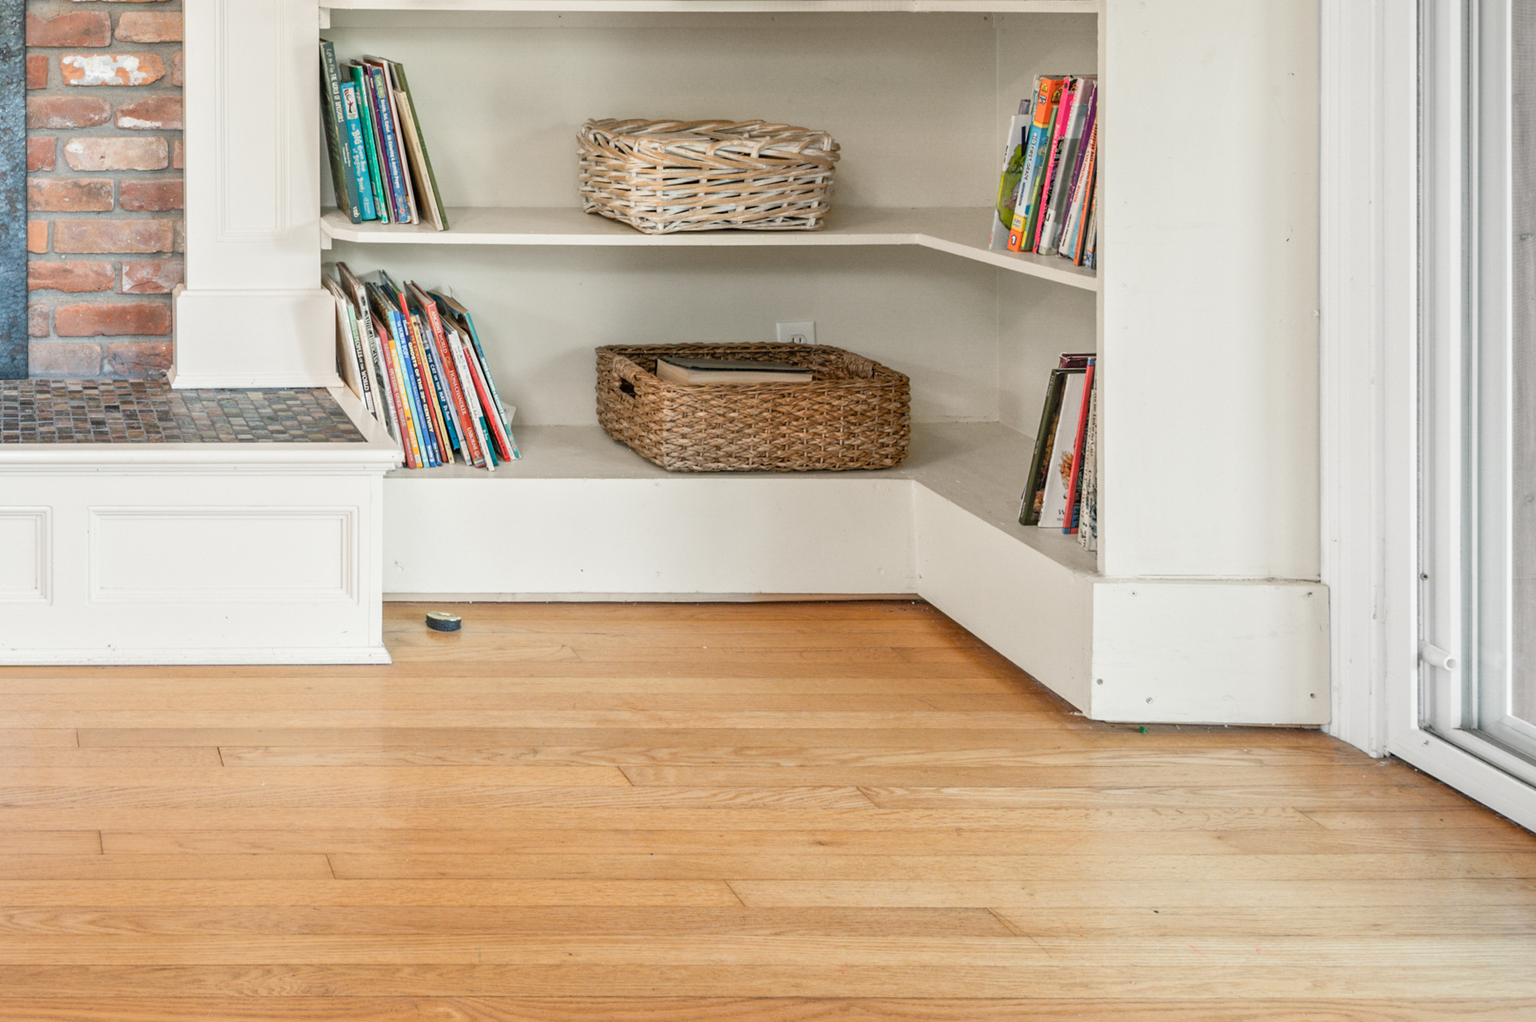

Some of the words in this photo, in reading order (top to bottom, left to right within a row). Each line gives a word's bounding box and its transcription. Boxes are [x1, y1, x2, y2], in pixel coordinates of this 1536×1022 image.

[330, 73, 338, 81] THE
[351, 130, 363, 145] BIG
[1027, 145, 1036, 161] FIRST
[1023, 163, 1033, 181] GRADE
[1009, 234, 1017, 245] 1
[352, 337, 364, 358] PEOPLES
[361, 370, 369, 391] WORLD
[431, 310, 442, 334] ANCIENT
[438, 333, 448, 354] WORLD
[448, 369, 458, 386] FIONA
[454, 386, 466, 416] CHANDLER
[408, 341, 418, 367] GHOSTS
[423, 404, 434, 433] CENTURY
[438, 391, 446, 402] HAT
